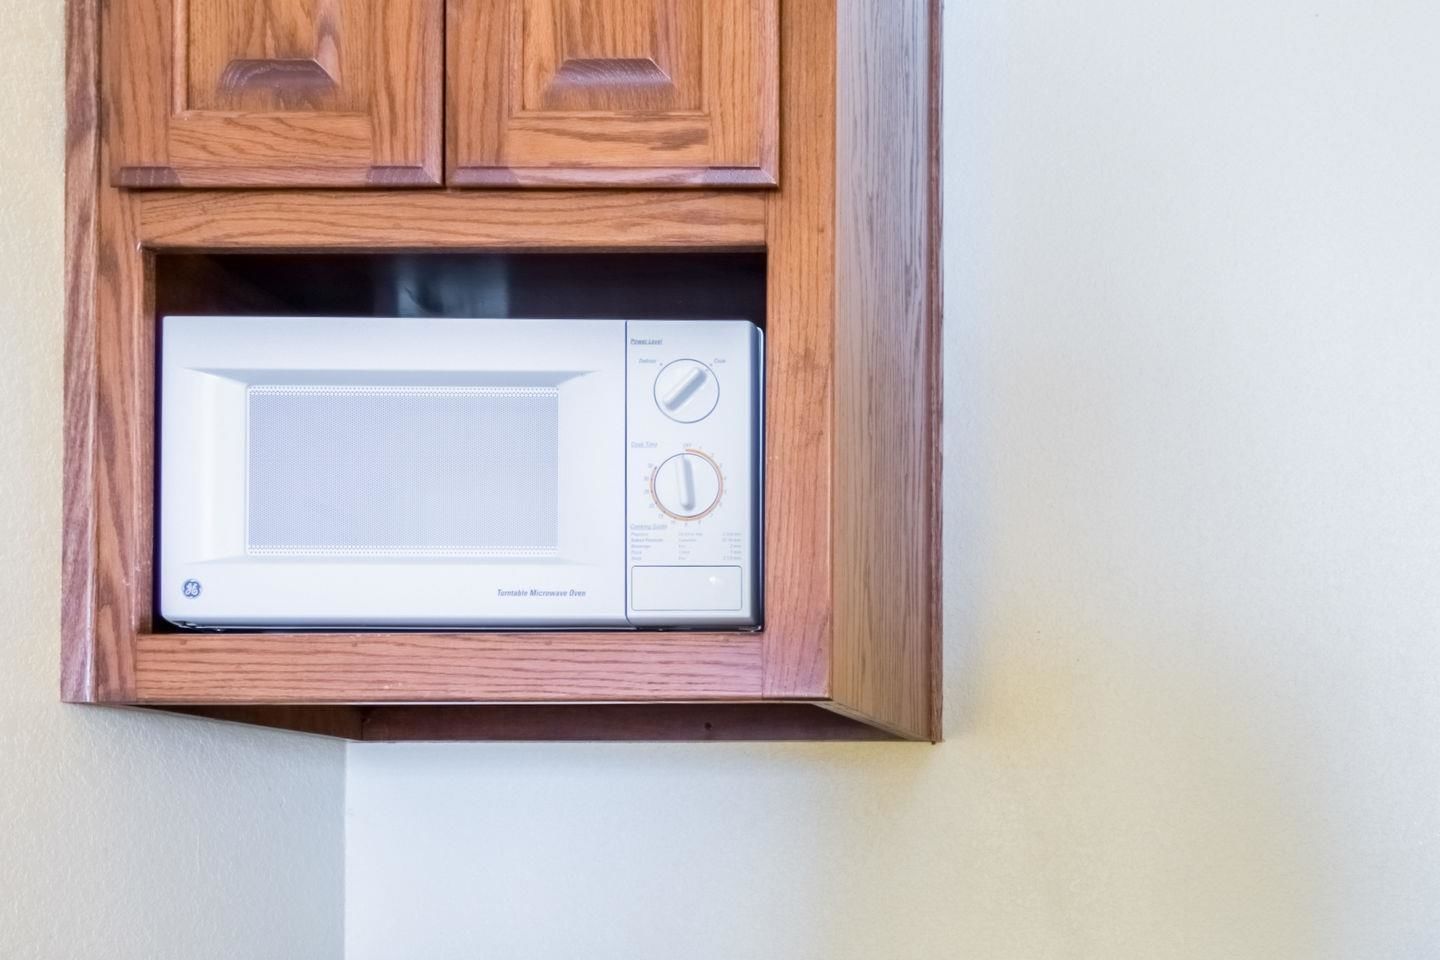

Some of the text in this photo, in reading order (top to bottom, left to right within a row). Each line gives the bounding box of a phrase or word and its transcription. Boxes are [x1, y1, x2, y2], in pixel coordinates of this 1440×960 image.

[497, 589, 586, 597] Turntable Microwave Oven
